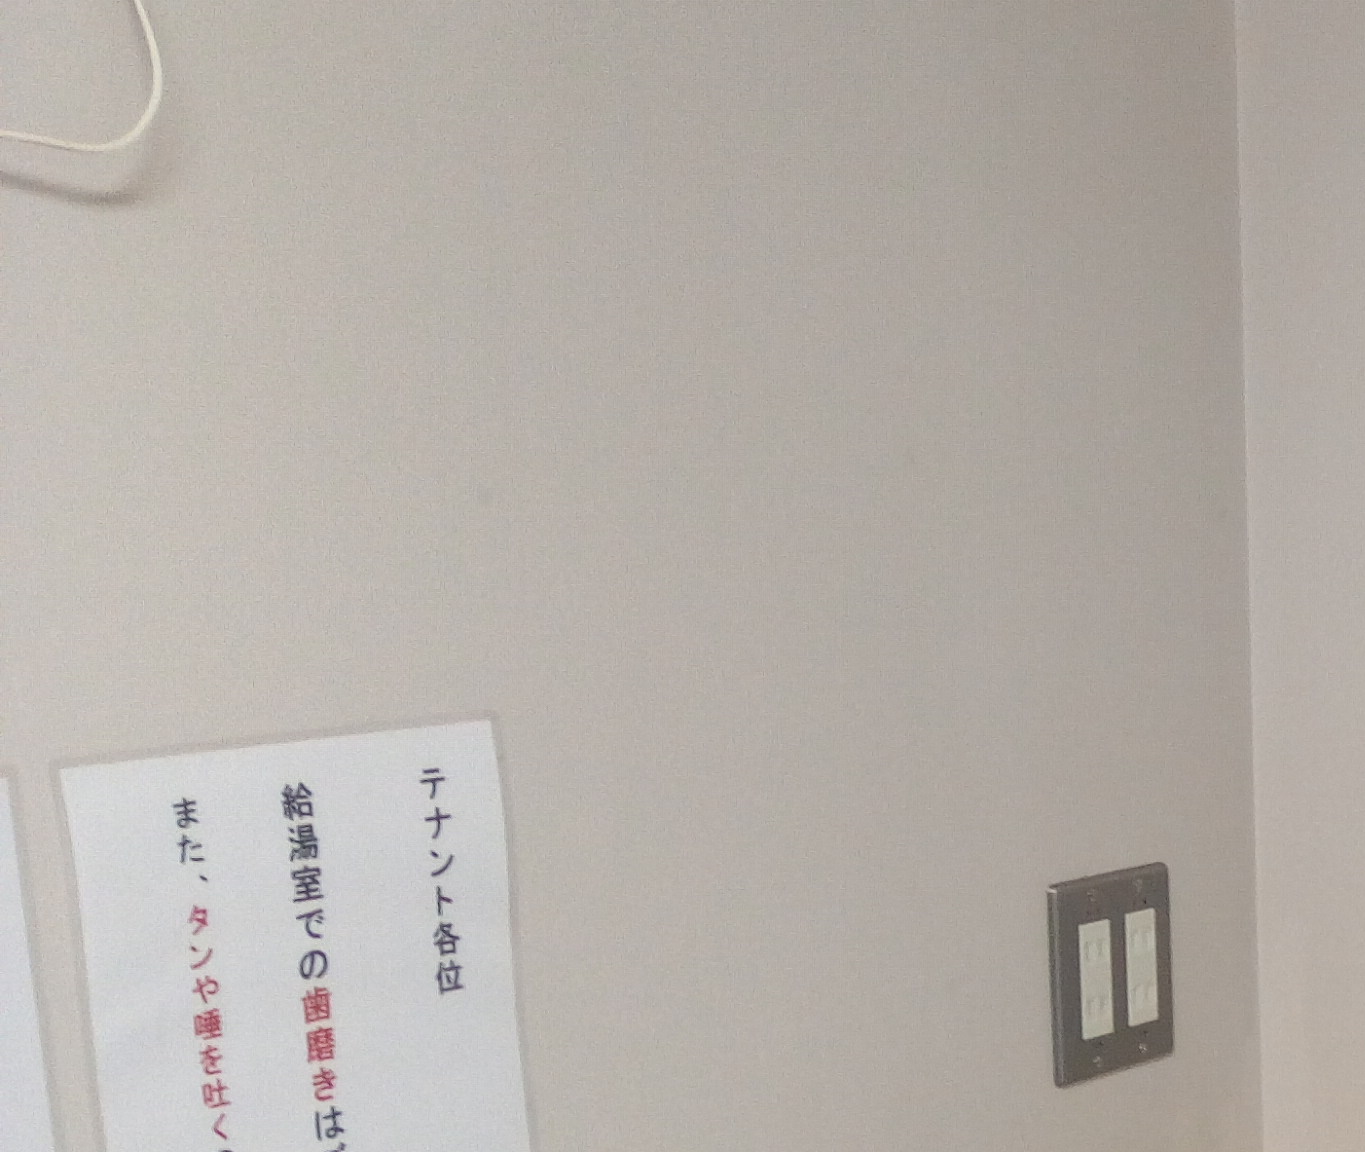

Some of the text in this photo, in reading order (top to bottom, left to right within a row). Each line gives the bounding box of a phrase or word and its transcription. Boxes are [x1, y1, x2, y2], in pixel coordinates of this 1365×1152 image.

[418, 766, 464, 994] テナント各位
